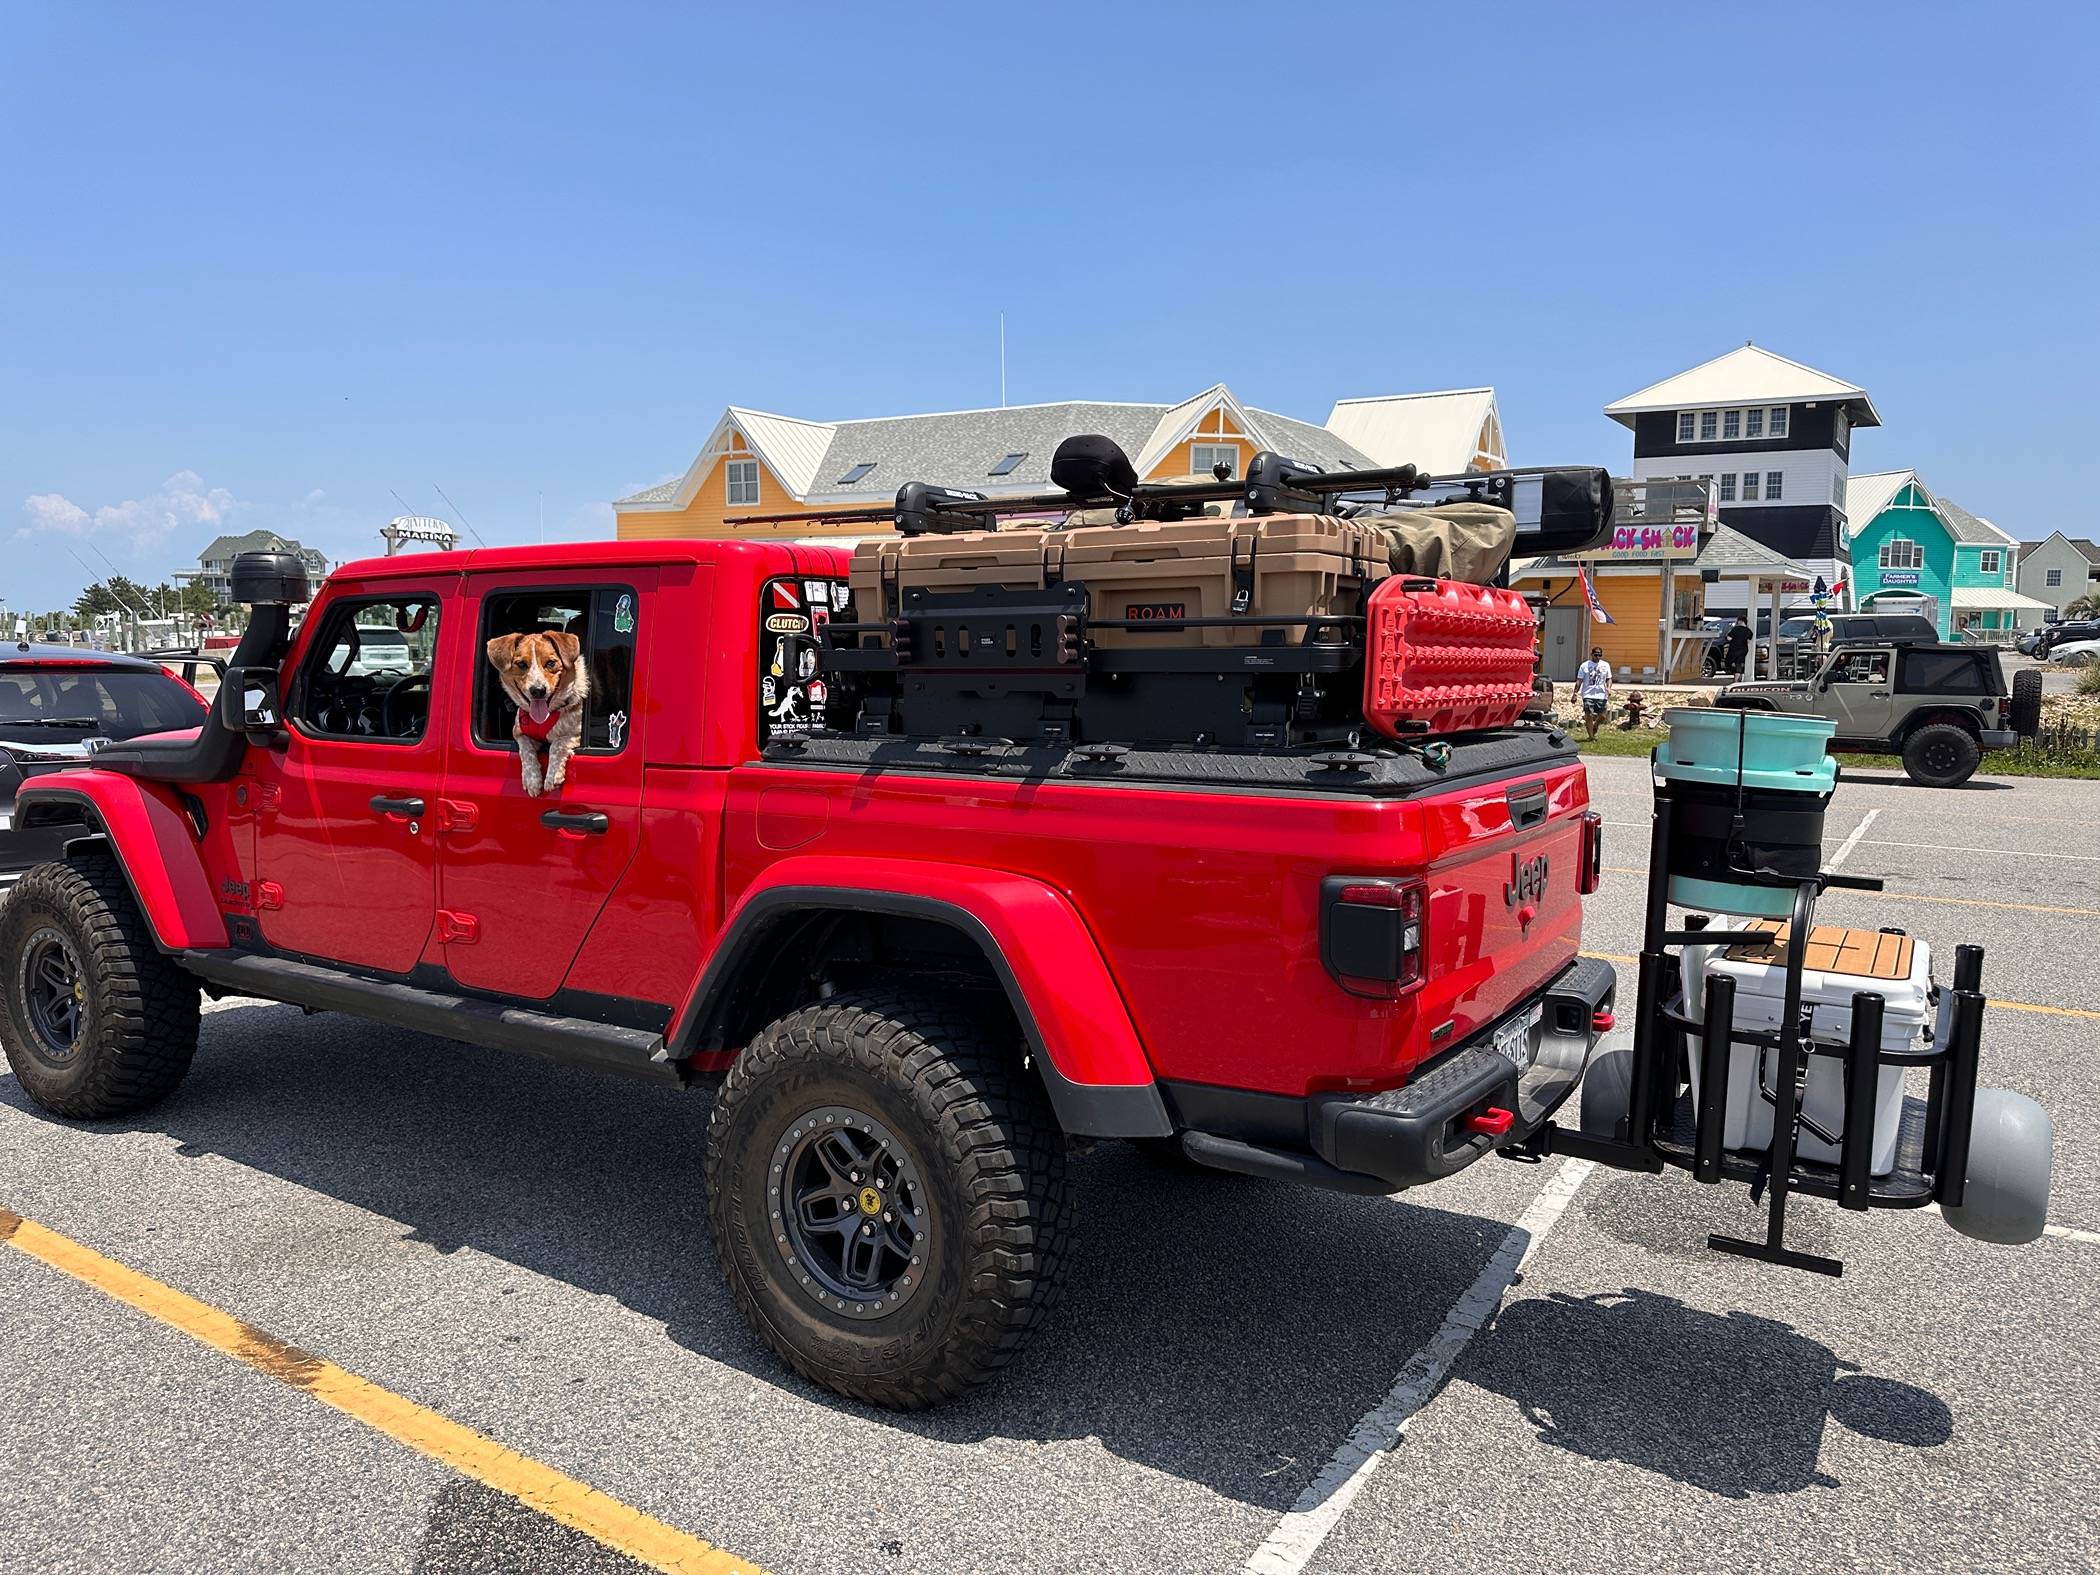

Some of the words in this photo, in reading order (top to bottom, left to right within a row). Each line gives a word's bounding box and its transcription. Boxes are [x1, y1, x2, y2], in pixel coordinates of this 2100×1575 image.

[399, 530, 453, 541] MARINA
[1612, 551, 1629, 559] GOOD
[1632, 550, 1648, 558] FOOD
[1650, 550, 1665, 558] FAST
[1128, 607, 1183, 620] ROAM
[770, 618, 804, 629] CLUTCH
[1503, 852, 1549, 906] Jeep
[221, 874, 251, 901] Jeep
